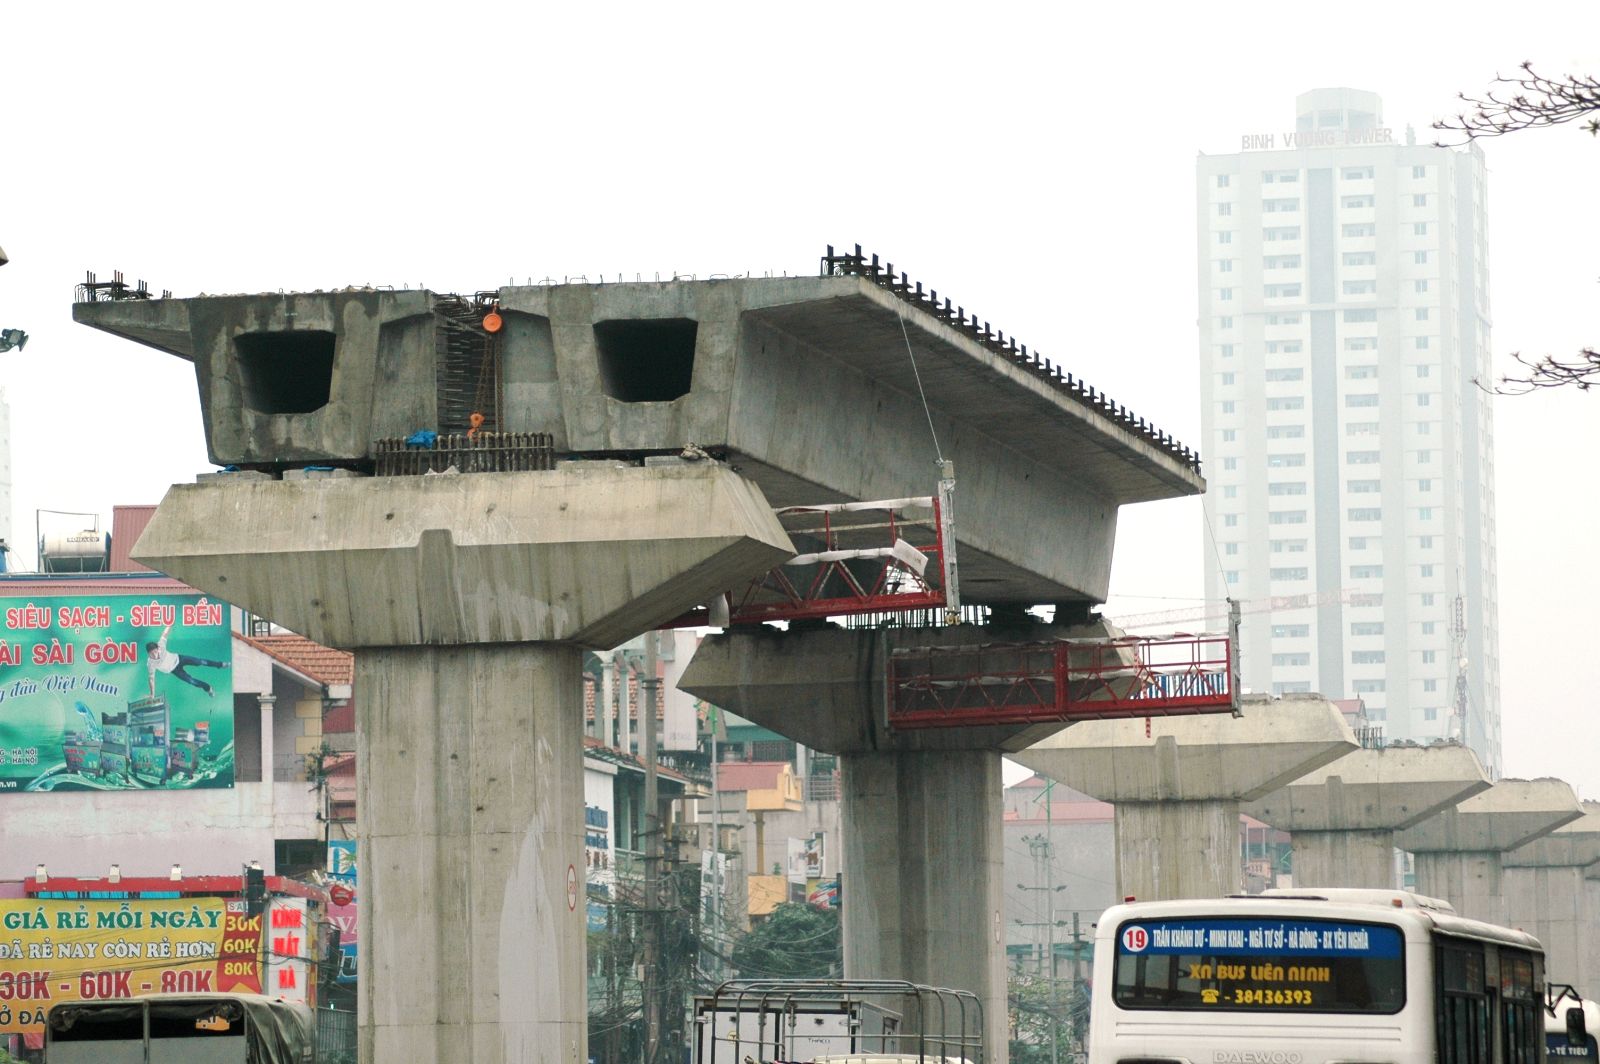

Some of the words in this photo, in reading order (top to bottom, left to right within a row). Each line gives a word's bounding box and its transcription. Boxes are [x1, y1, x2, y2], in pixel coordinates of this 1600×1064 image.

[1343, 128, 1393, 145] TOWER
[6, 603, 51, 629] SIÊU
[58, 605, 110, 634] SẠCH
[130, 600, 175, 626] SIÊU
[183, 597, 222, 626] BỀN
[32, 638, 74, 665] SÀI
[84, 637, 137, 664] GÒN
[4, 907, 49, 929] GIÁ
[56, 905, 89, 929] RẺ
[96, 903, 143, 929] MỖI
[150, 906, 222, 929] NGÀY
[226, 916, 260, 931] 30K
[1126, 930, 1146, 948] 19
[1171, 925, 1193, 947] KHÁNH
[1209, 929, 1227, 948] MINH
[1227, 929, 1244, 948] KHAI
[0, 939, 24, 959] ĐÃ
[28, 937, 54, 959] RẺ
[57, 943, 99, 959] NAY
[102, 938, 142, 958] CÒN
[146, 937, 171, 958] RẺ
[175, 940, 216, 959] HƠN
[223, 939, 256, 953] 60K
[224, 962, 254, 975] 80K
[1216, 965, 1246, 979] BUS
[1250, 963, 1284, 981] LIÊN
[1288, 966, 1330, 981] NINH
[0, 971, 51, 1000] 30K
[79, 970, 133, 999] 60K
[161, 970, 213, 992] 80K
[1234, 989, 1313, 1004] 38436393
[18, 1007, 46, 1025] ĐÂ
[1212, 1050, 1303, 1064] DAEWOO
